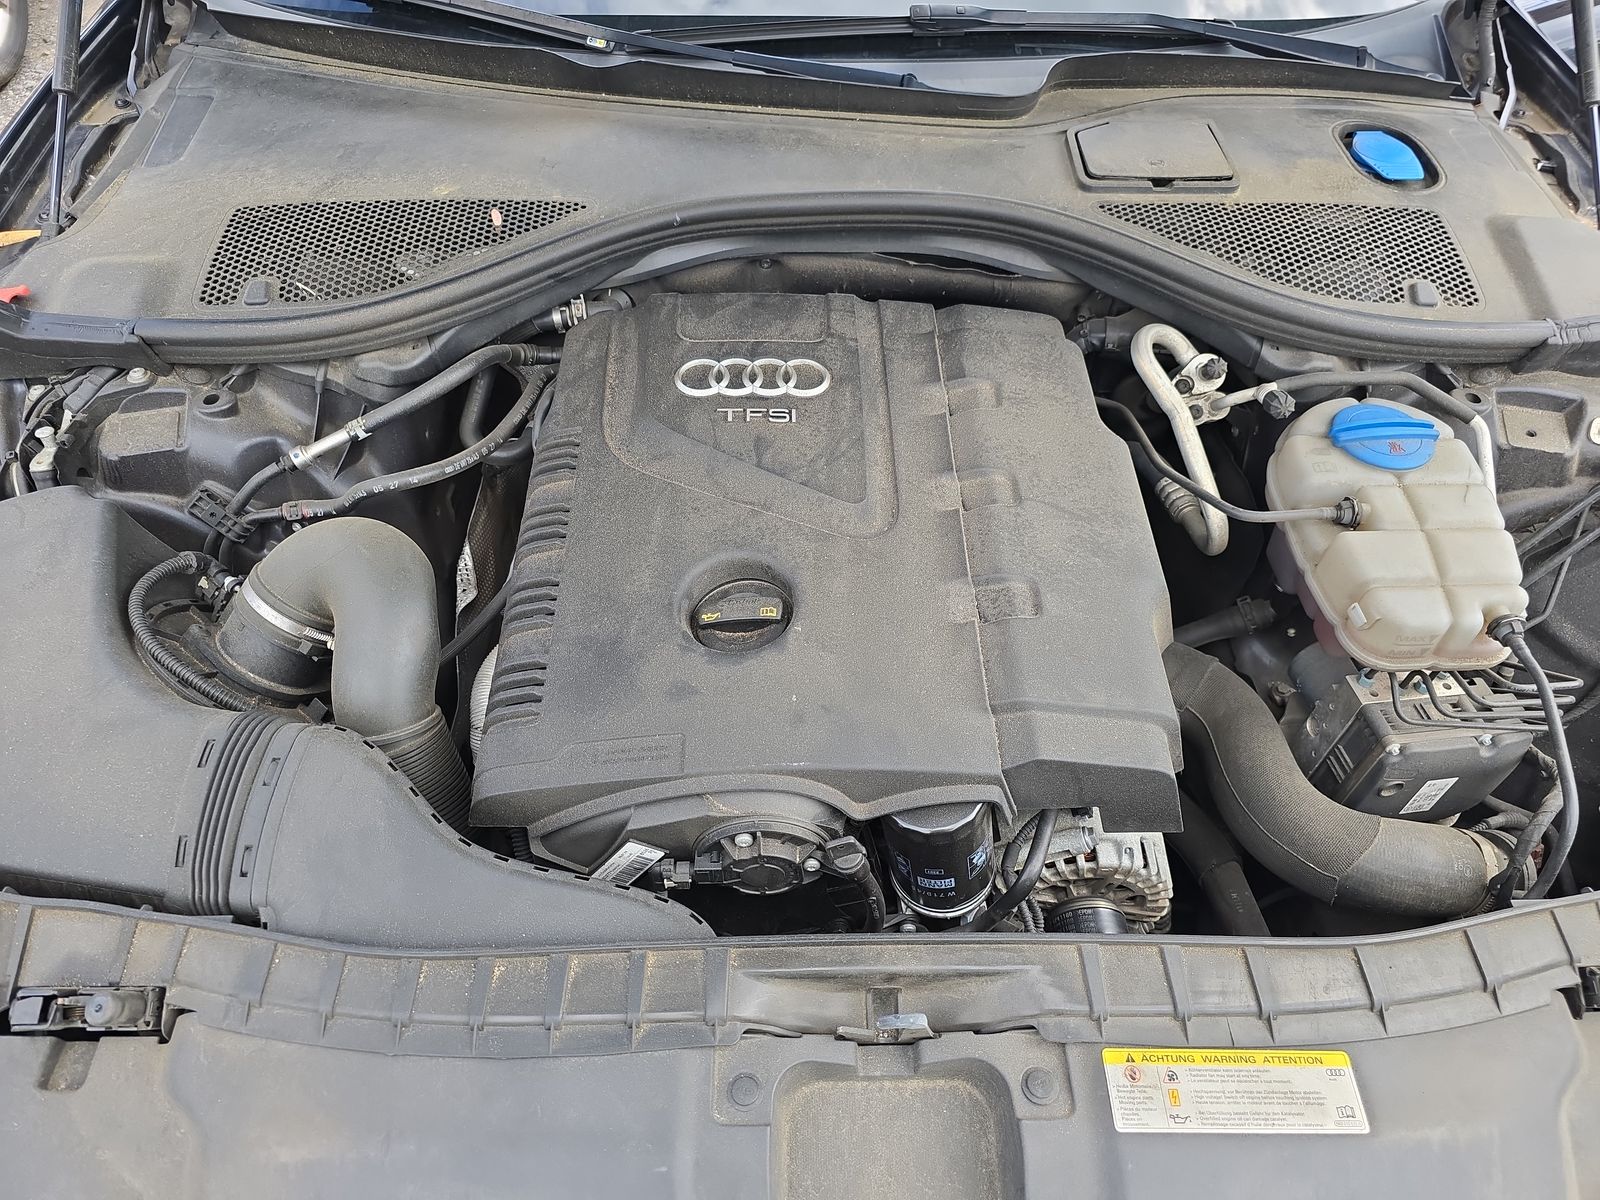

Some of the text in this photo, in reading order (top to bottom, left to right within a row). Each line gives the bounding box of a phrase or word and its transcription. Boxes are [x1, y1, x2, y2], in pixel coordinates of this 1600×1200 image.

[717, 408, 797, 423] TFSI
[372, 484, 384, 494] 05
[388, 480, 399, 490] 27
[1141, 1054, 1324, 1066] ACHTUNG WARNING ATTENTION
